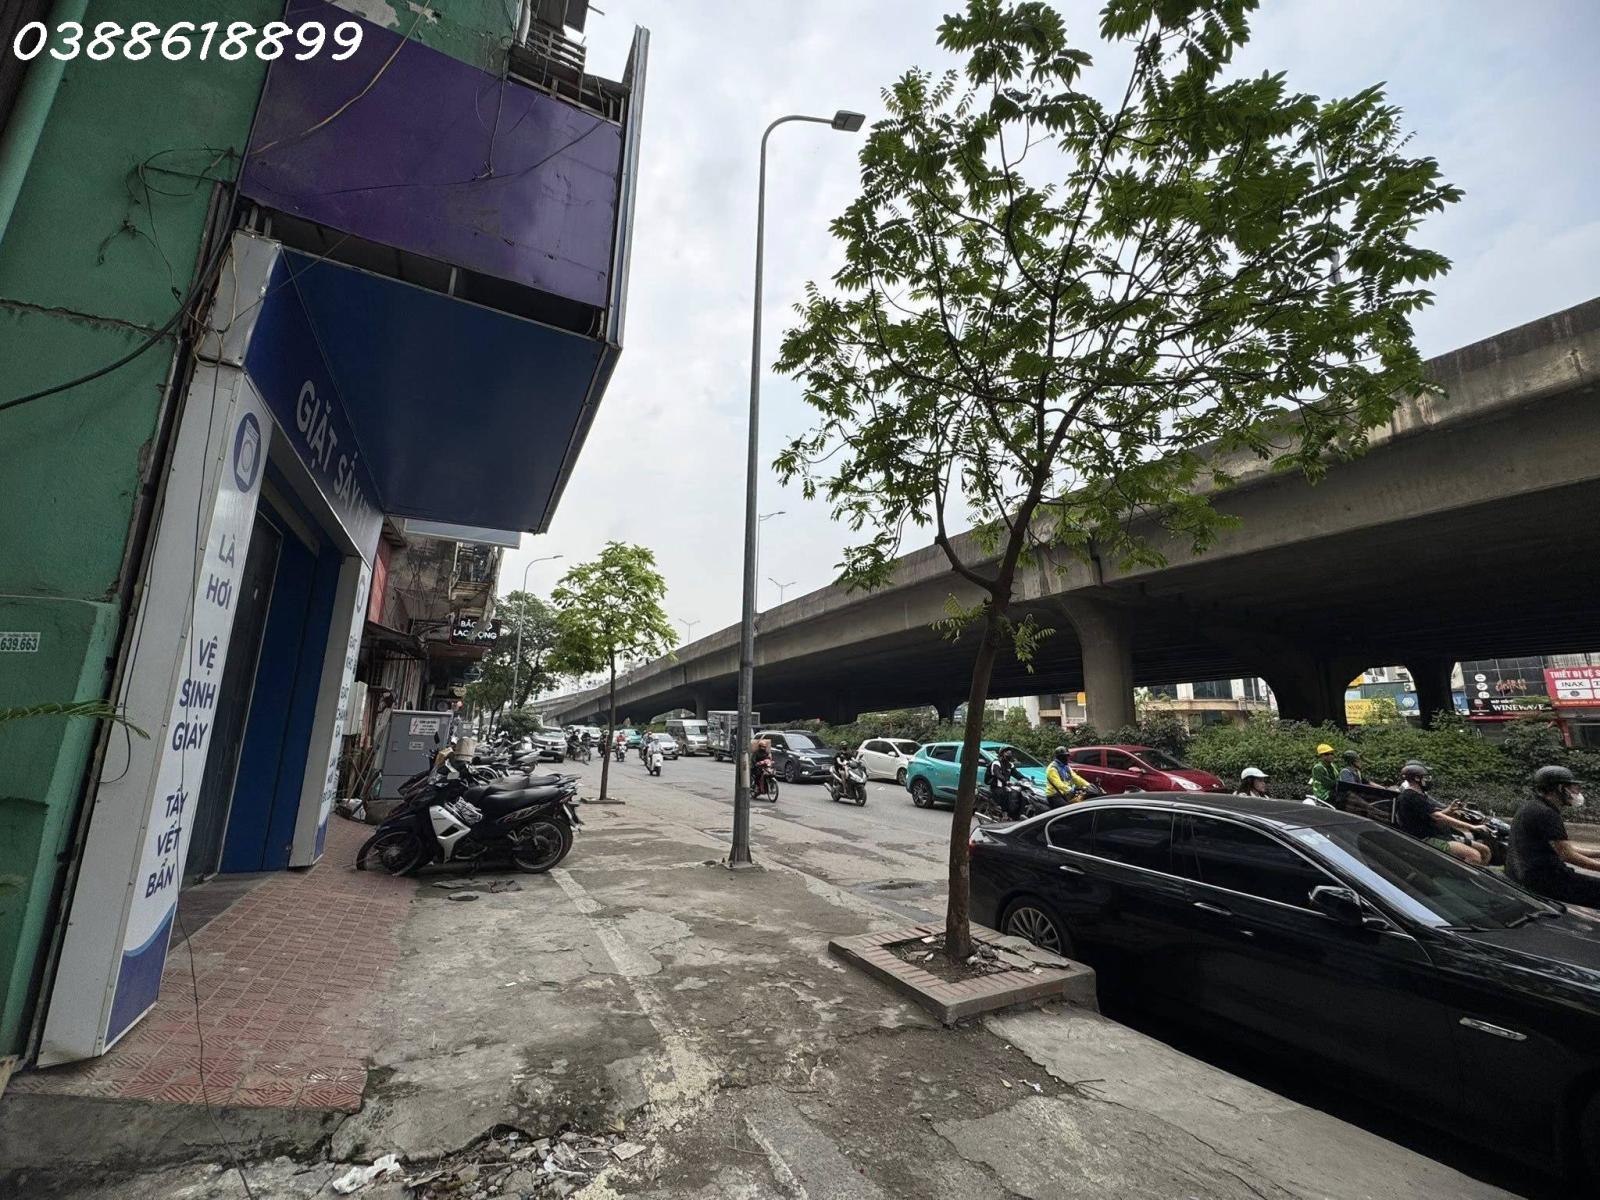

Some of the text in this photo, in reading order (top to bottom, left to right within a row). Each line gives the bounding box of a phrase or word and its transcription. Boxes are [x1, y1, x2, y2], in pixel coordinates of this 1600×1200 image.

[296, 380, 338, 472] GIẶT
[218, 533, 236, 568] LÀ
[206, 572, 232, 610] HƠI
[199, 635, 218, 676] VỆ
[179, 679, 216, 709] SINH
[172, 714, 208, 751] GIÀY
[157, 820, 182, 857] VẾT
